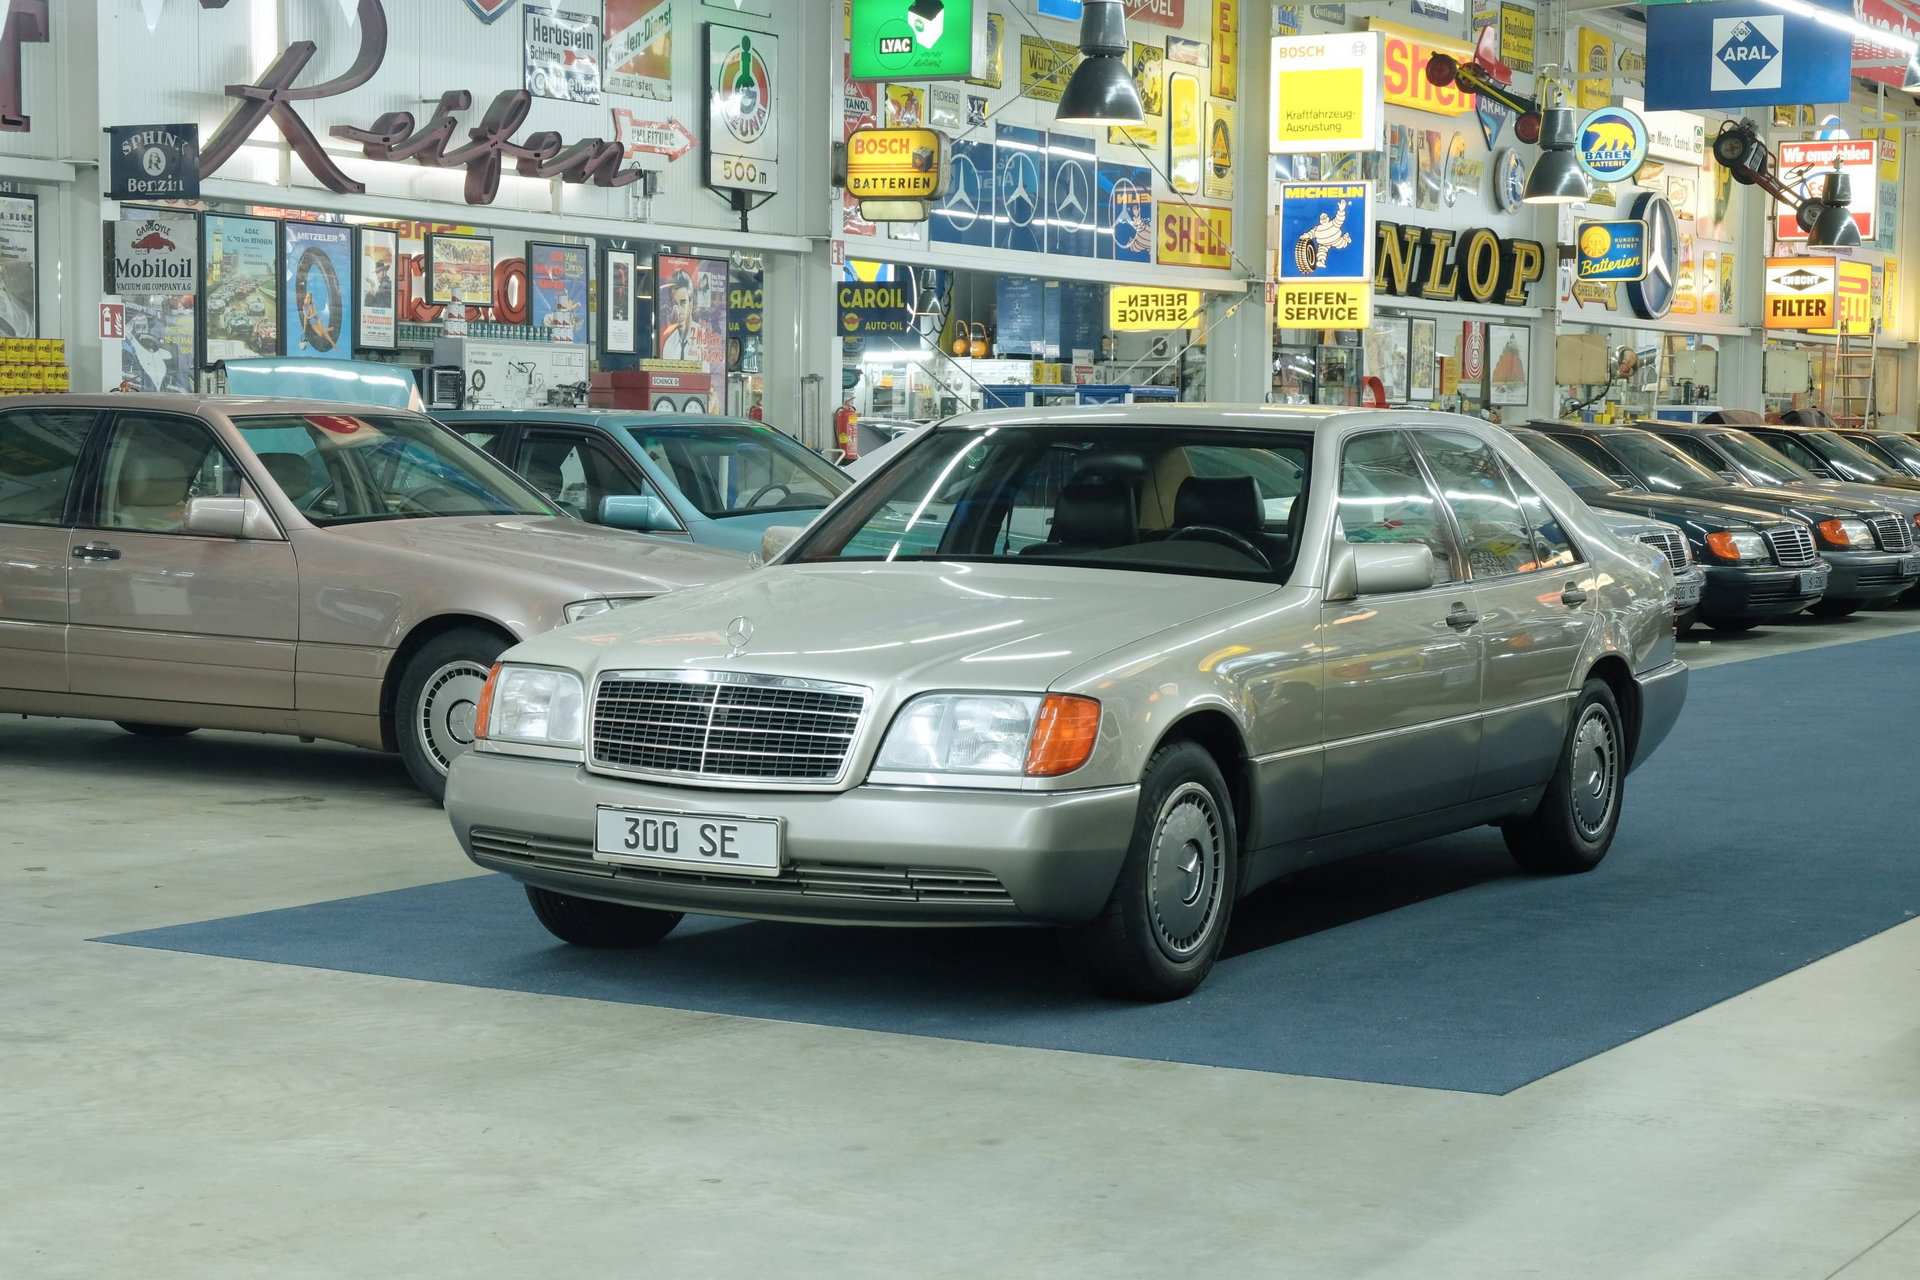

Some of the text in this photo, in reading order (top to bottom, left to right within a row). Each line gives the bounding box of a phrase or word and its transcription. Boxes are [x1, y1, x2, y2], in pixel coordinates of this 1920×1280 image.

[533, 17, 594, 50] Herbstein
[881, 38, 912, 53] LYAC
[1217, 0, 1231, 95] ELL
[1280, 46, 1325, 59] BOSCH
[1723, 46, 1772, 61] ARAL
[1028, 49, 1074, 74] Würzburg
[934, 89, 960, 104] FLORENZ
[844, 98, 870, 111] TANOL
[1286, 109, 1357, 121] Kraftfahrzeug-
[854, 138, 910, 155] BOSCH
[1585, 150, 1632, 160] BÄREN
[1783, 145, 1870, 164] Wir empfehlen
[1590, 160, 1627, 168] BATTERIE
[723, 160, 767, 184] 500 m
[128, 174, 184, 193] Benzin
[853, 177, 931, 189] BATTERIEN
[1285, 186, 1364, 199] MICHELIN
[244, 227, 260, 236] ADAC
[297, 231, 338, 243] METZELER
[1164, 213, 1228, 256] SHELL
[116, 258, 193, 278] Mobiloil
[1377, 221, 1544, 306] NLOP
[1580, 254, 1641, 276] Batterien
[116, 282, 141, 291] VACUUM
[151, 283, 182, 291] COMPANY
[839, 288, 904, 308] CAROIL
[1284, 291, 1358, 306] REIFEN-
[1284, 307, 1359, 322] SERVICE
[1772, 299, 1827, 317] FILTER
[1838, 296, 1868, 323] ELLI
[864, 321, 904, 331] AUTO-OIL
[653, 377, 674, 386] SCHENCK
[624, 816, 740, 859] 300 SE
